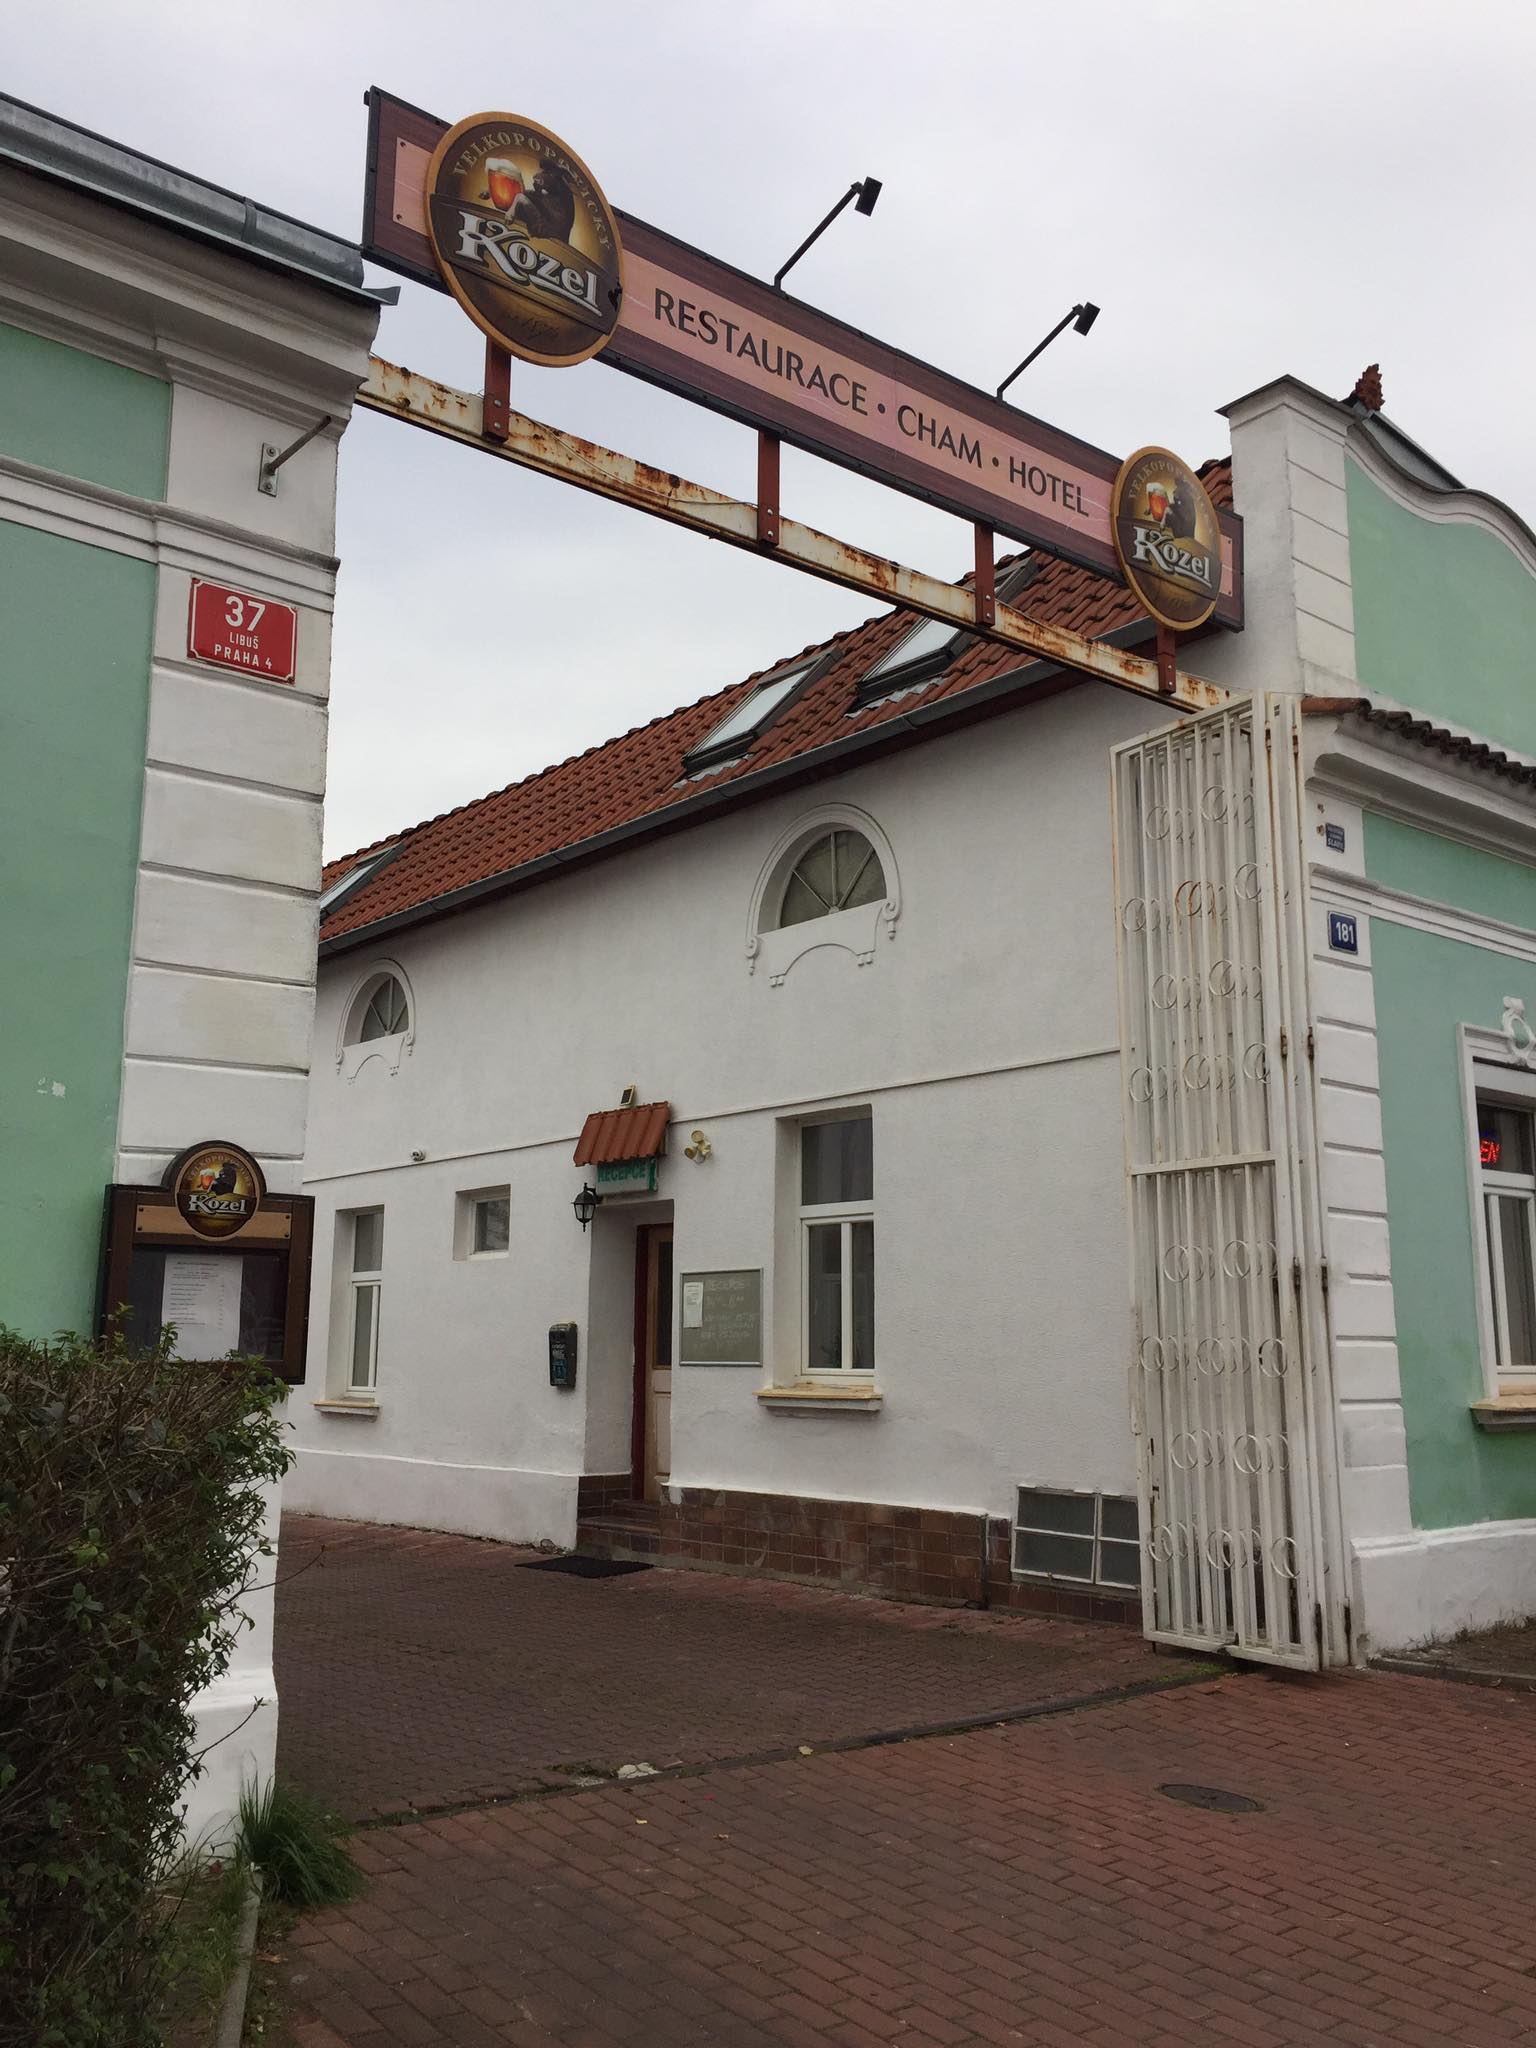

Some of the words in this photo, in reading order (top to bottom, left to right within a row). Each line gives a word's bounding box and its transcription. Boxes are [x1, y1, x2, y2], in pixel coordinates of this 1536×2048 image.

[456, 210, 602, 316] Kozel
[654, 288, 868, 416] RESTAURACE
[897, 404, 982, 469] CHAM
[1009, 460, 1089, 518] HOTEL
[1132, 526, 1213, 588] Kozel
[225, 595, 265, 631] 37
[229, 631, 259, 650] LIBUŠ
[214, 643, 259, 667] PRAHA
[265, 657, 273, 670] 4
[1336, 921, 1354, 944] 181
[188, 1194, 248, 1215] Kozel
